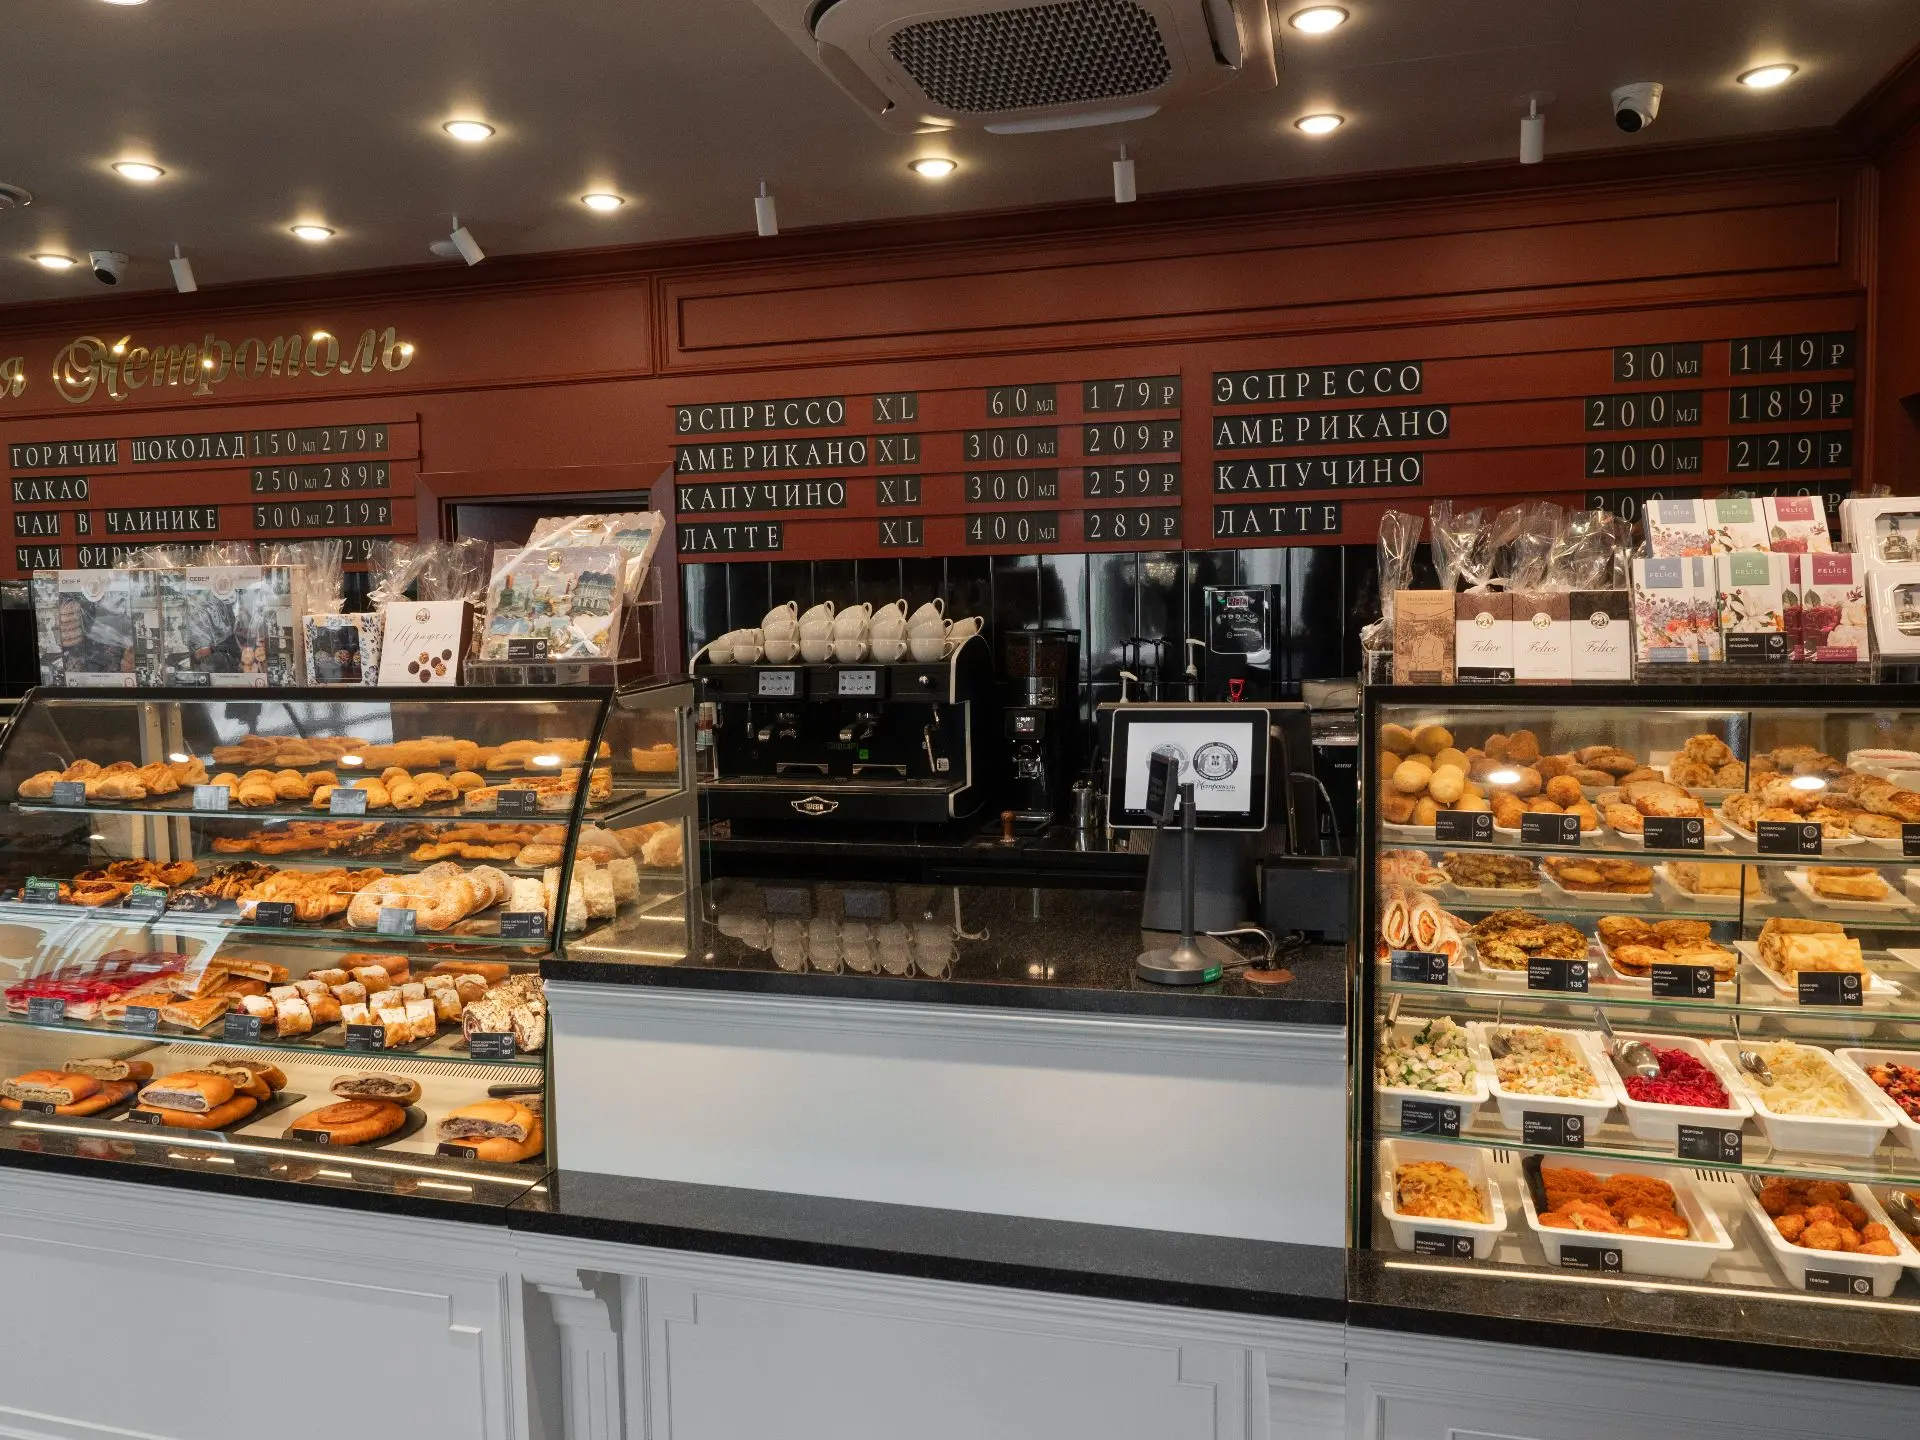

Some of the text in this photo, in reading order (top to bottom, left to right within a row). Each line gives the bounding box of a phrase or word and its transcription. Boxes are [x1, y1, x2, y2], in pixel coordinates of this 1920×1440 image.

[1217, 365, 1420, 402] ЭСПРЕССО
[679, 400, 843, 432] ЭСПРЕССО
[877, 397, 914, 421] XL
[1217, 409, 1448, 446] АМЕРИКАНО
[132, 436, 245, 461] ШОКОЛАД
[679, 441, 866, 471] АМЕРИКАНО
[879, 438, 916, 462] XL
[1218, 457, 1420, 490] КАПУЧИНО
[14, 479, 88, 501] КАКАО
[680, 482, 844, 510] КАПУЧИНО
[880, 479, 917, 503] XL
[78, 513, 88, 533] В
[1217, 505, 1336, 534] ЛАТТЕ
[682, 525, 779, 551] ЛАТТЕ
[882, 521, 919, 544] XL
